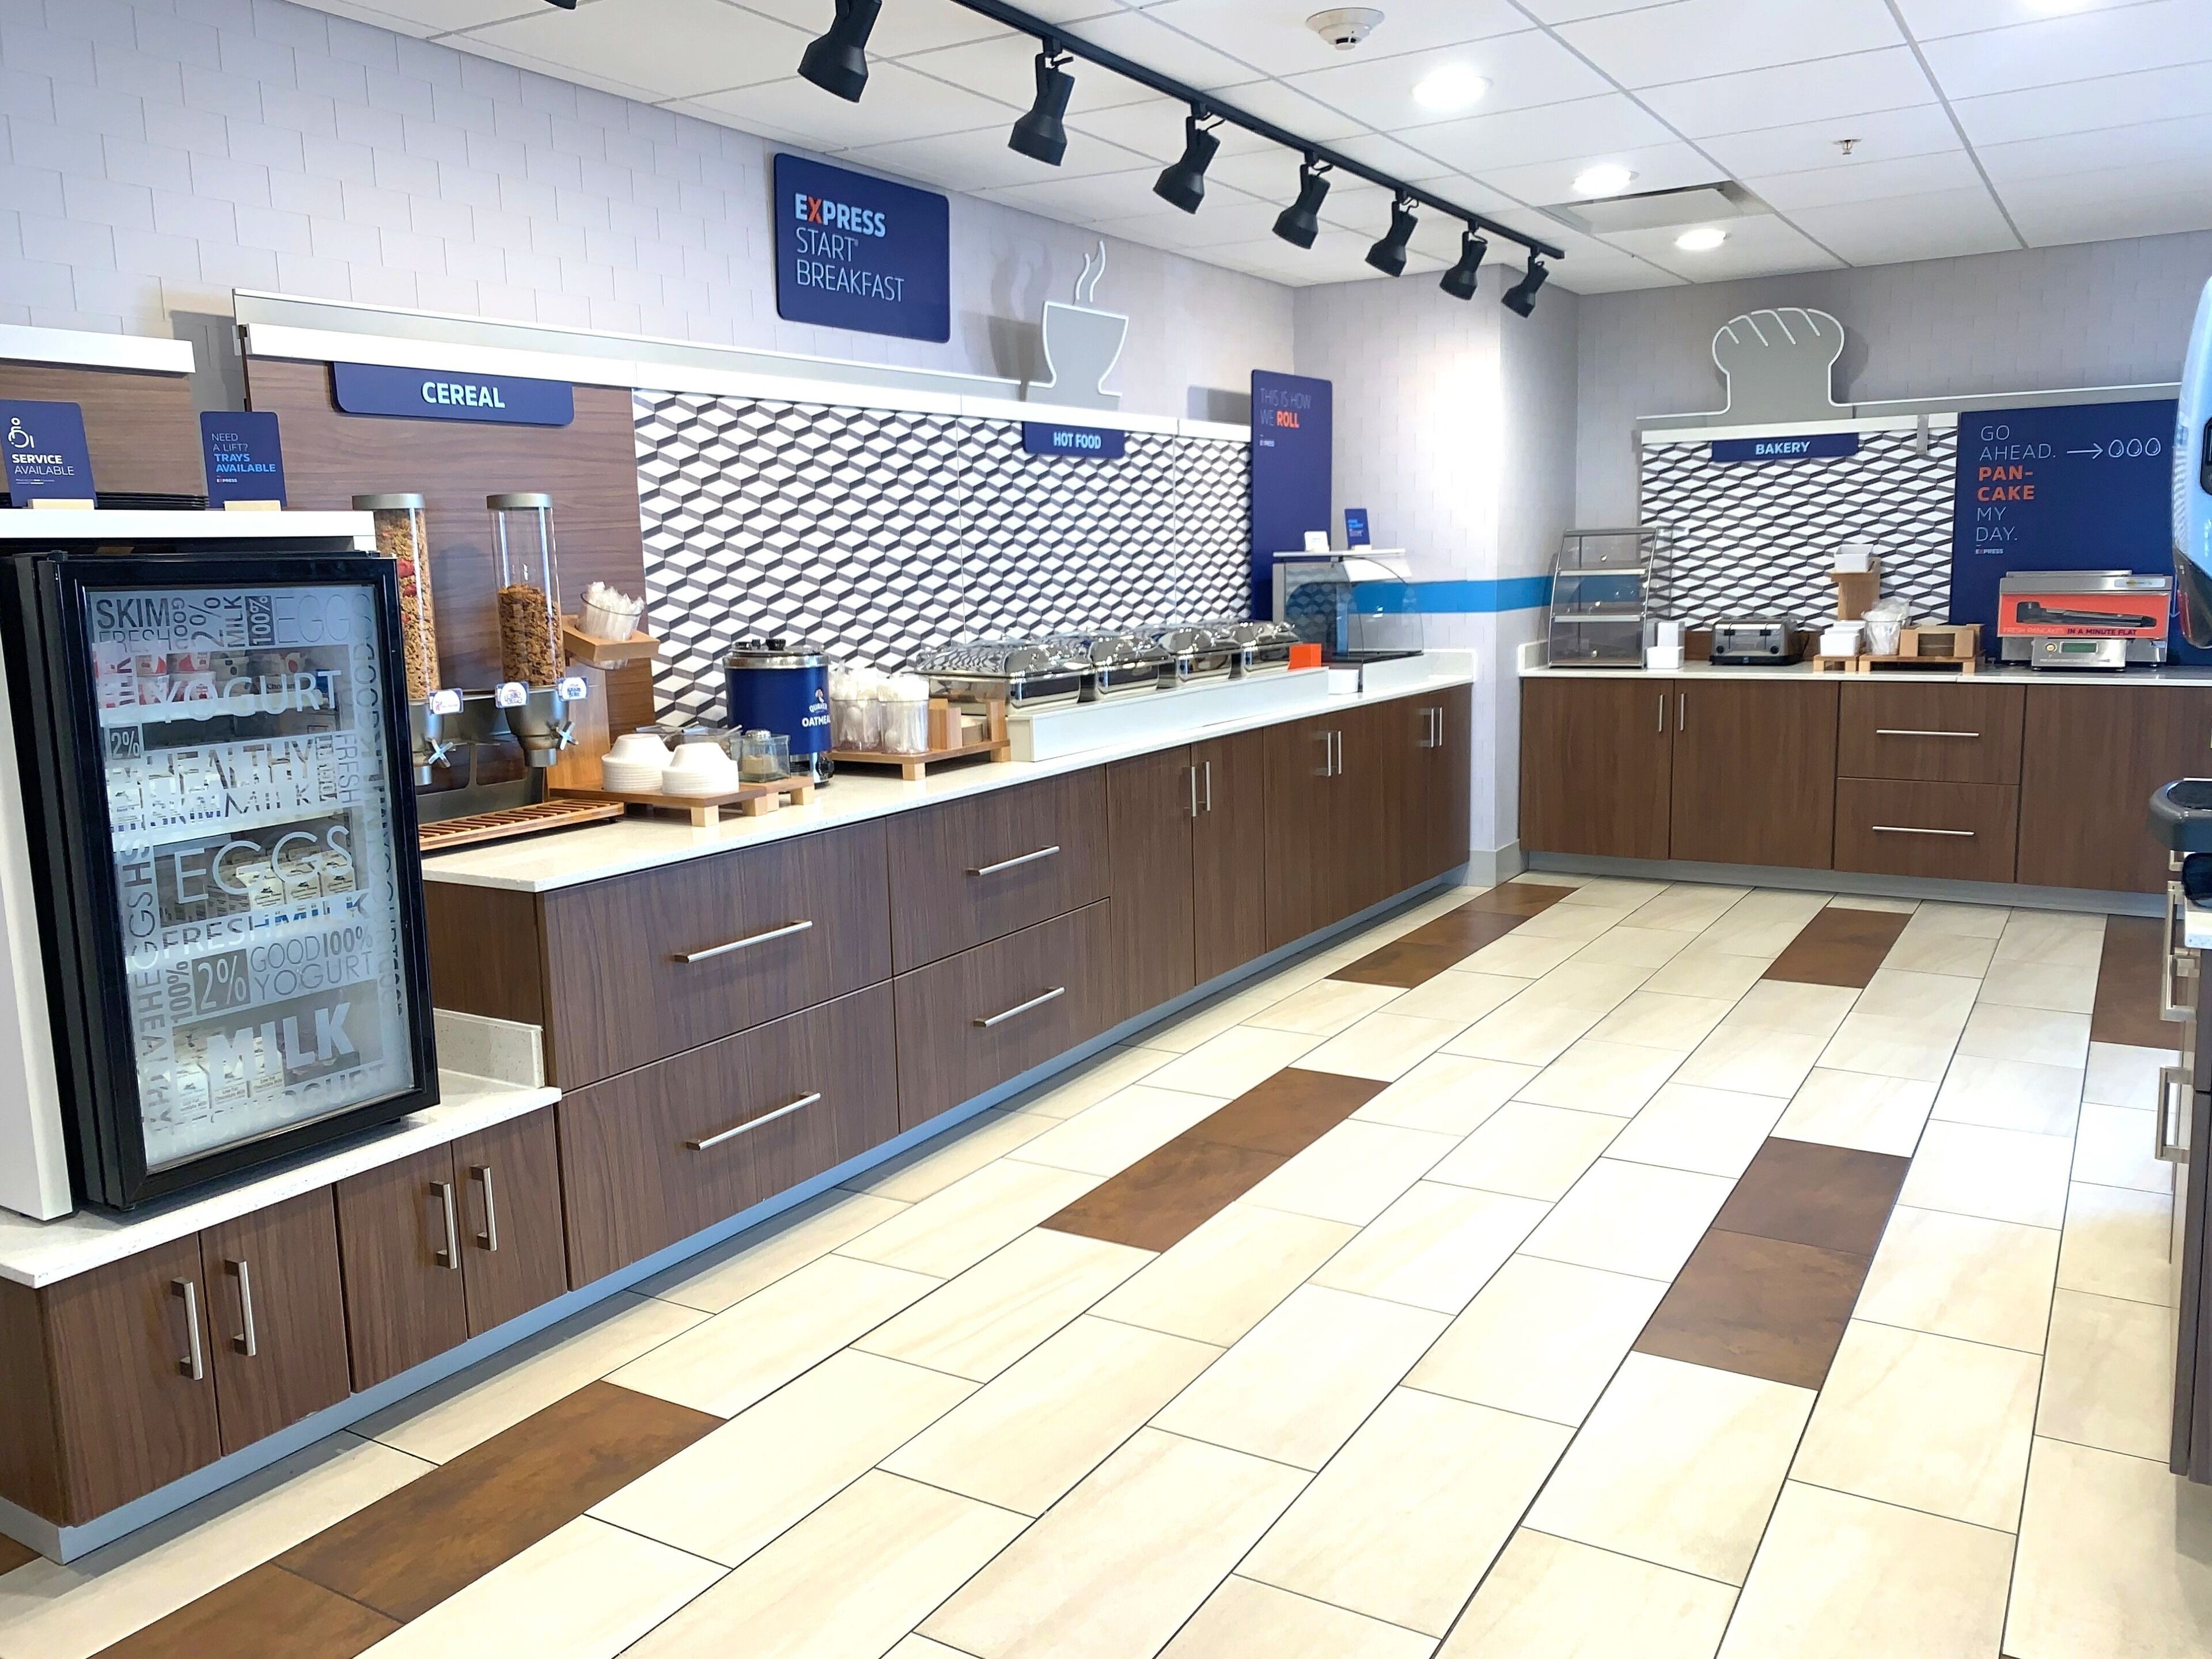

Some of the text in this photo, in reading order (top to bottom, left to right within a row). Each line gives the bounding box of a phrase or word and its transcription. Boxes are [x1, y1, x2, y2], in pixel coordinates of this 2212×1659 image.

[794, 192, 886, 238] EXPRESS
[797, 259, 905, 302] BREAKFAST
[421, 381, 506, 408] CEREAL
[1277, 410, 1300, 428] ROLL
[211, 433, 239, 442] NEED
[1054, 432, 1102, 449] HOT FOOD
[1980, 425, 2010, 441] GO
[12, 453, 63, 464] SERVICE
[213, 443, 248, 452] A LIFT?
[214, 453, 251, 462] TRAYS
[1755, 441, 1810, 455] BAKERY
[1979, 443, 2056, 461] AHEAD.
[14, 465, 75, 476] AVAILABLE
[216, 463, 276, 472] AVAILABLE
[1978, 465, 2033, 482] PAN-
[1977, 485, 2035, 502] CAKE
[1977, 506, 2007, 521] MY
[1976, 526, 2018, 542] DAY.
[96, 597, 171, 629] SKIM
[188, 596, 225, 649] 2%
[223, 595, 246, 648] MILK
[249, 596, 272, 646] 100%
[99, 628, 172, 653] FRESH
[153, 669, 342, 724] YOGURT
[110, 730, 141, 759] 2%
[174, 825, 353, 904] EGGS
[251, 925, 374, 972] GOOD 100%
[198, 955, 248, 1010] 2%
[254, 951, 374, 1000] YOGURT
[166, 960, 193, 1024] 100%
[206, 1001, 355, 1089] MILK
